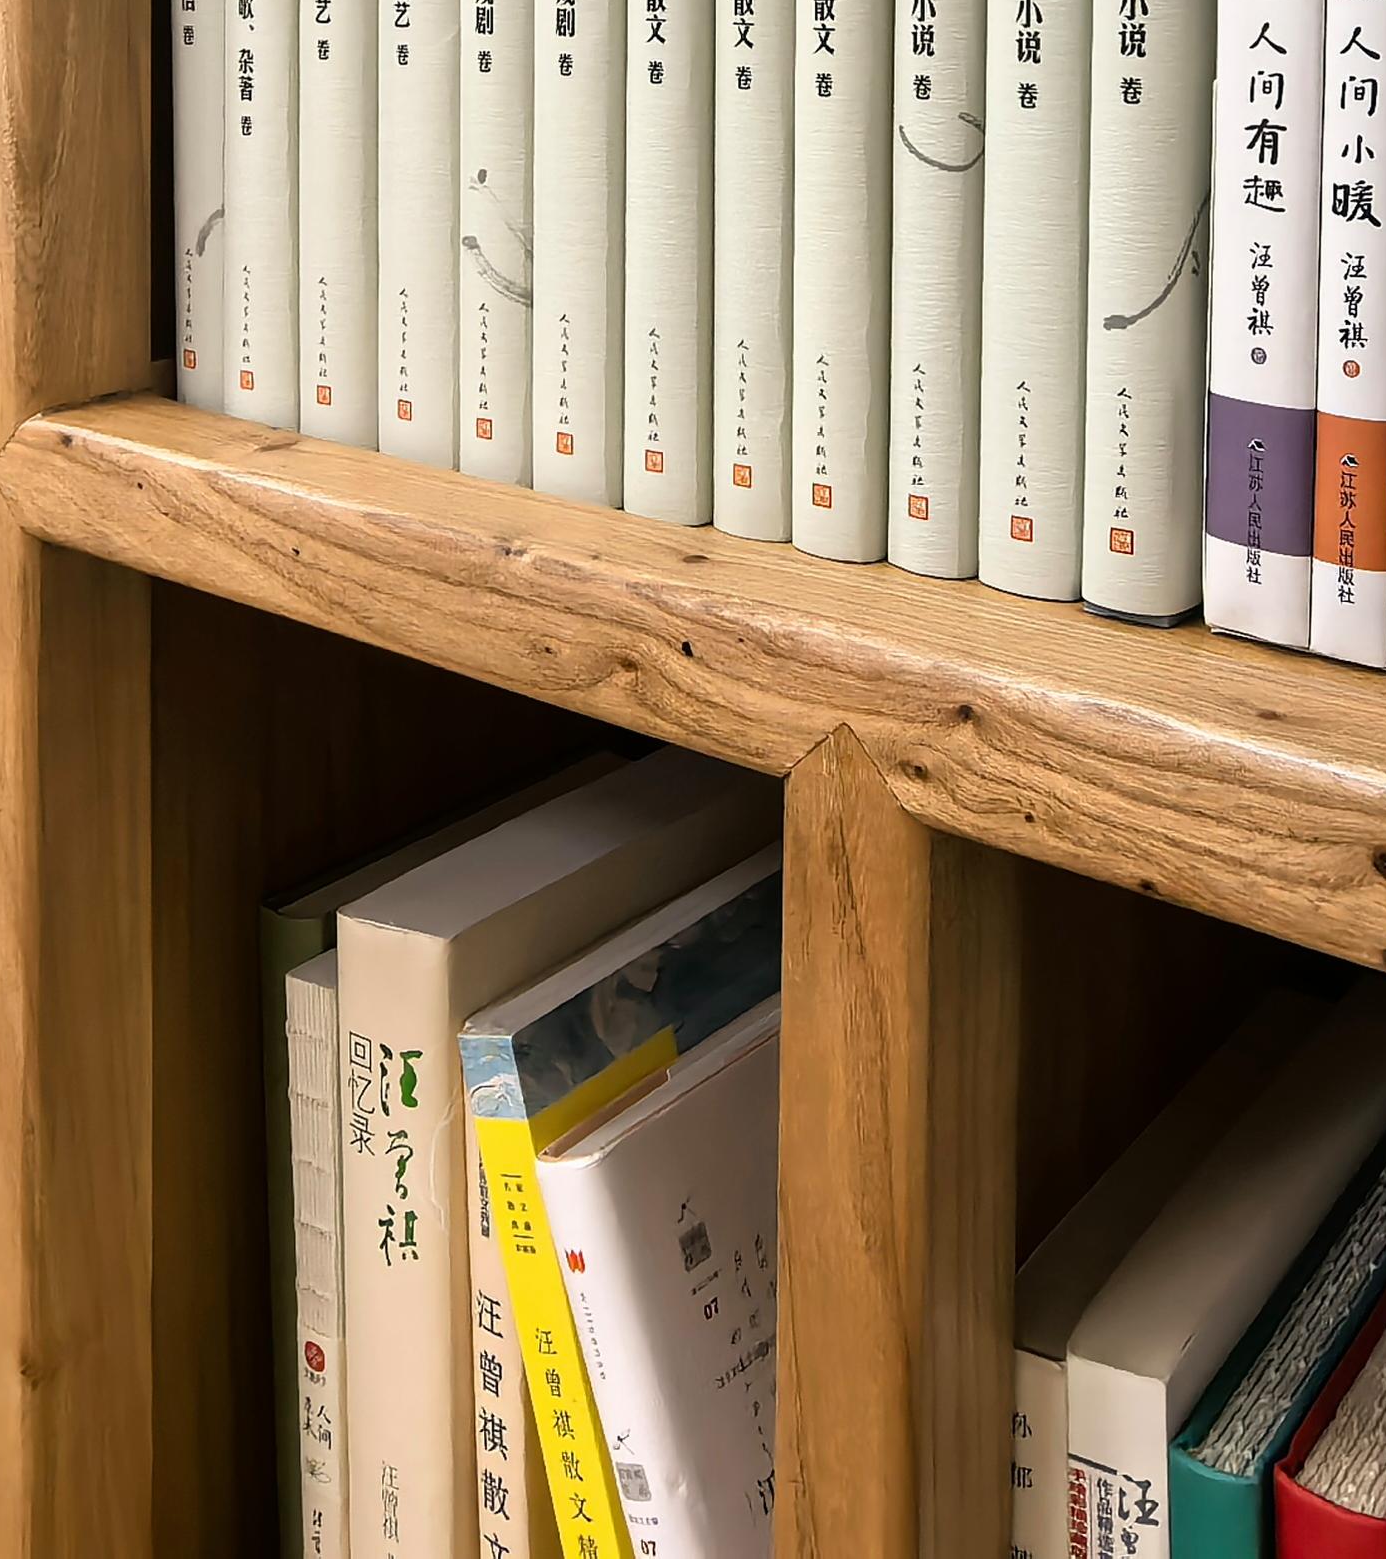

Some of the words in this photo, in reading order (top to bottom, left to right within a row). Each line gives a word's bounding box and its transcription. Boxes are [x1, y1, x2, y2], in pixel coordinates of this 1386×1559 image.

[1242, 21, 1288, 213] 人间有趣
[1331, 26, 1382, 228] 人间小暖
[1246, 241, 1274, 336] 汪曾祺
[1338, 251, 1369, 350] 汪曾祺
[1245, 448, 1267, 588] 江苏人民出版社
[1335, 468, 1359, 608] 江苏人民出版社
[347, 1030, 376, 1156] 回忆录
[1118, 1473, 1160, 1559] 汪曾
